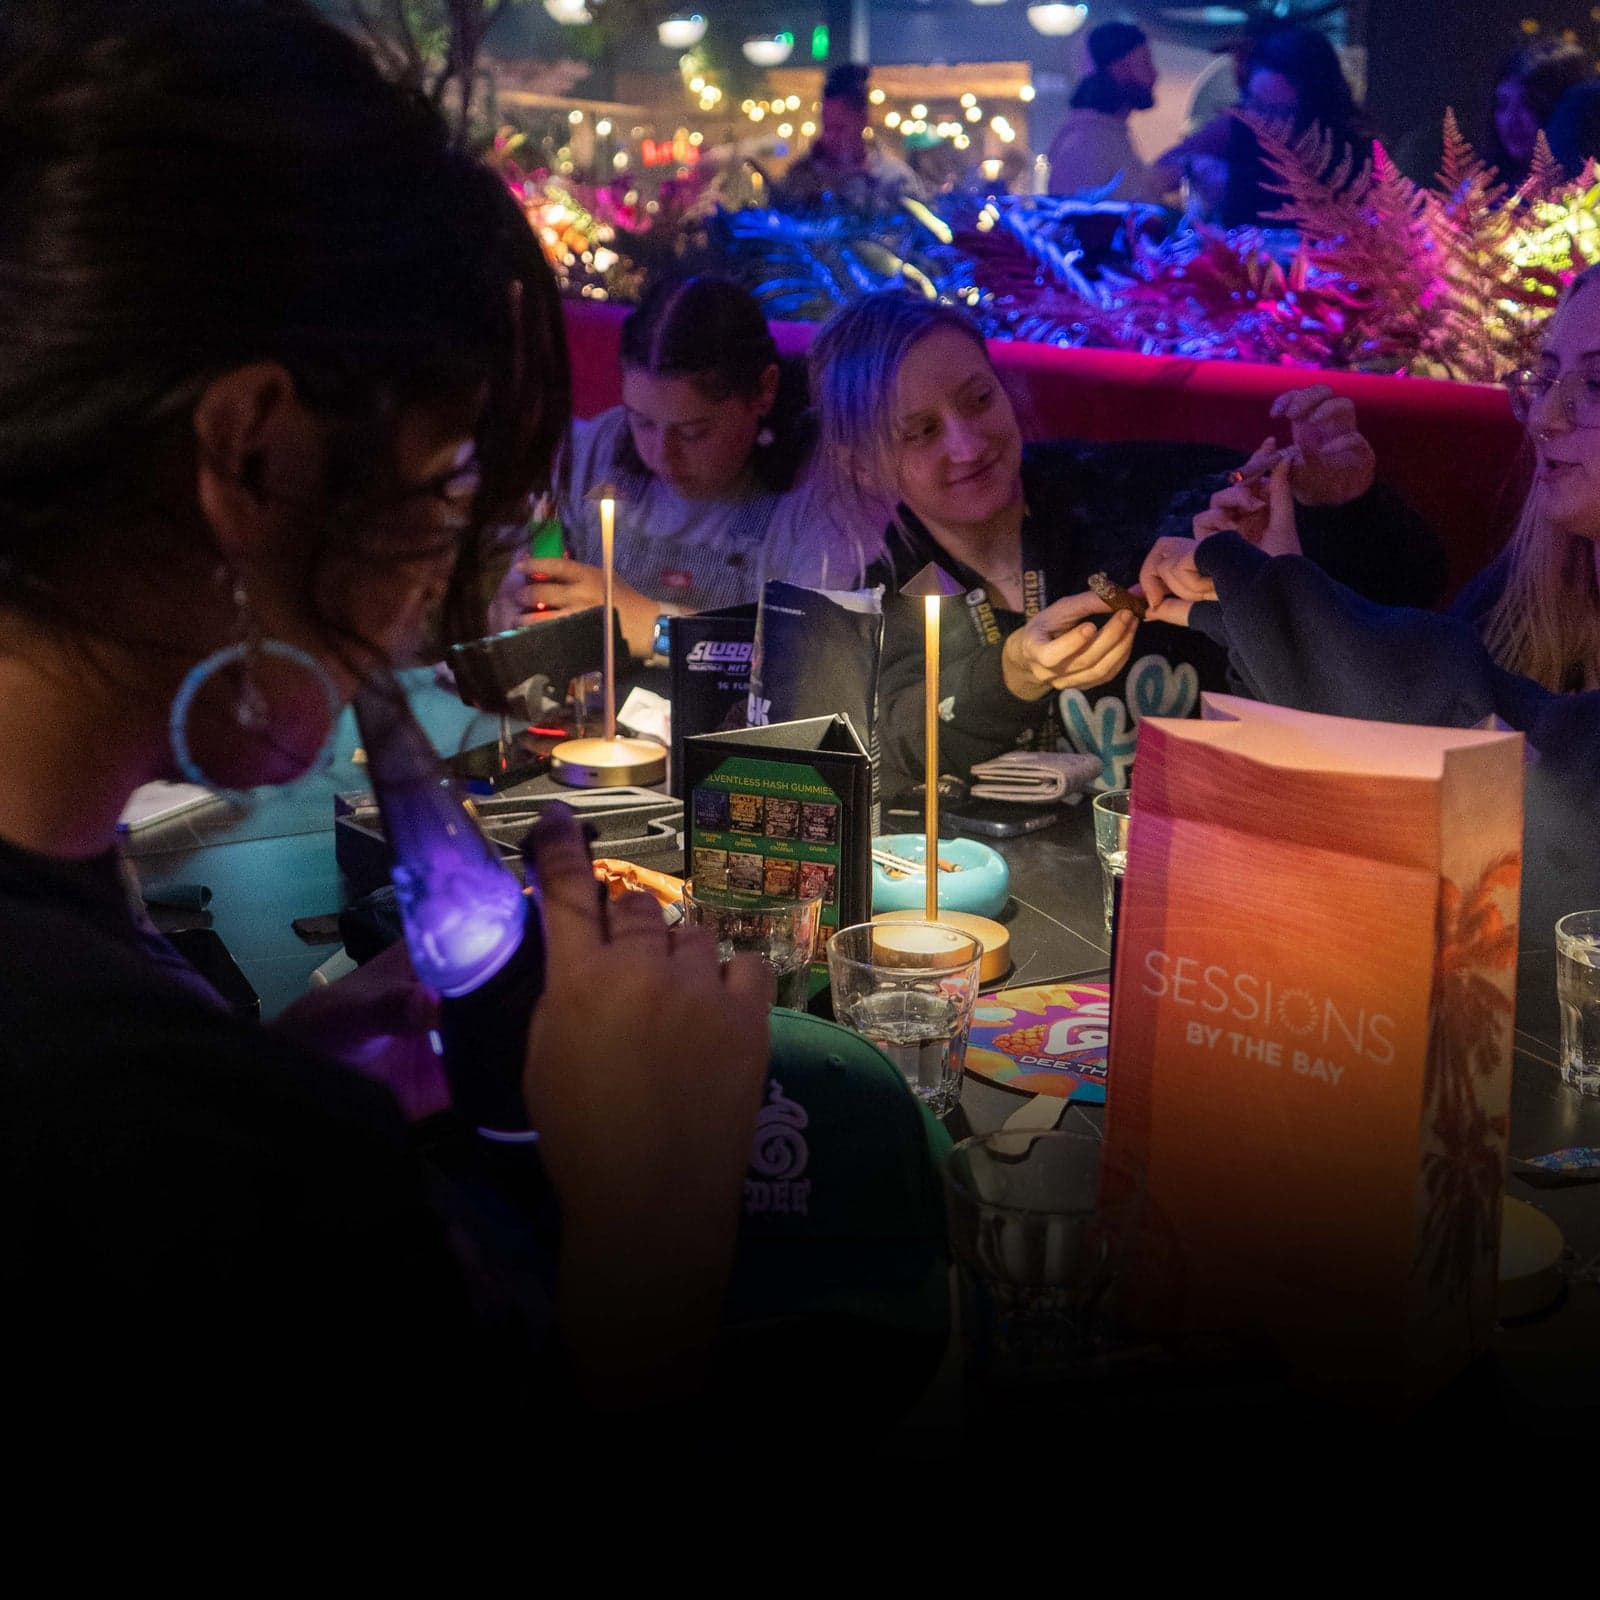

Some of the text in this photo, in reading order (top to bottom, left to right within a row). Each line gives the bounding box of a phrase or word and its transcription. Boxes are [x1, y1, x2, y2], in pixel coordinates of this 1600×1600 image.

[1023, 571, 1039, 623] GHTED
[976, 602, 1001, 645] DELIG
[762, 780, 789, 791] HASH
[791, 783, 834, 796] GUMMIES
[1142, 949, 1396, 1066] SESSIONS
[1019, 1055, 1108, 1077] DEE TH
[1186, 1020, 1345, 1087] BY THE BAY
